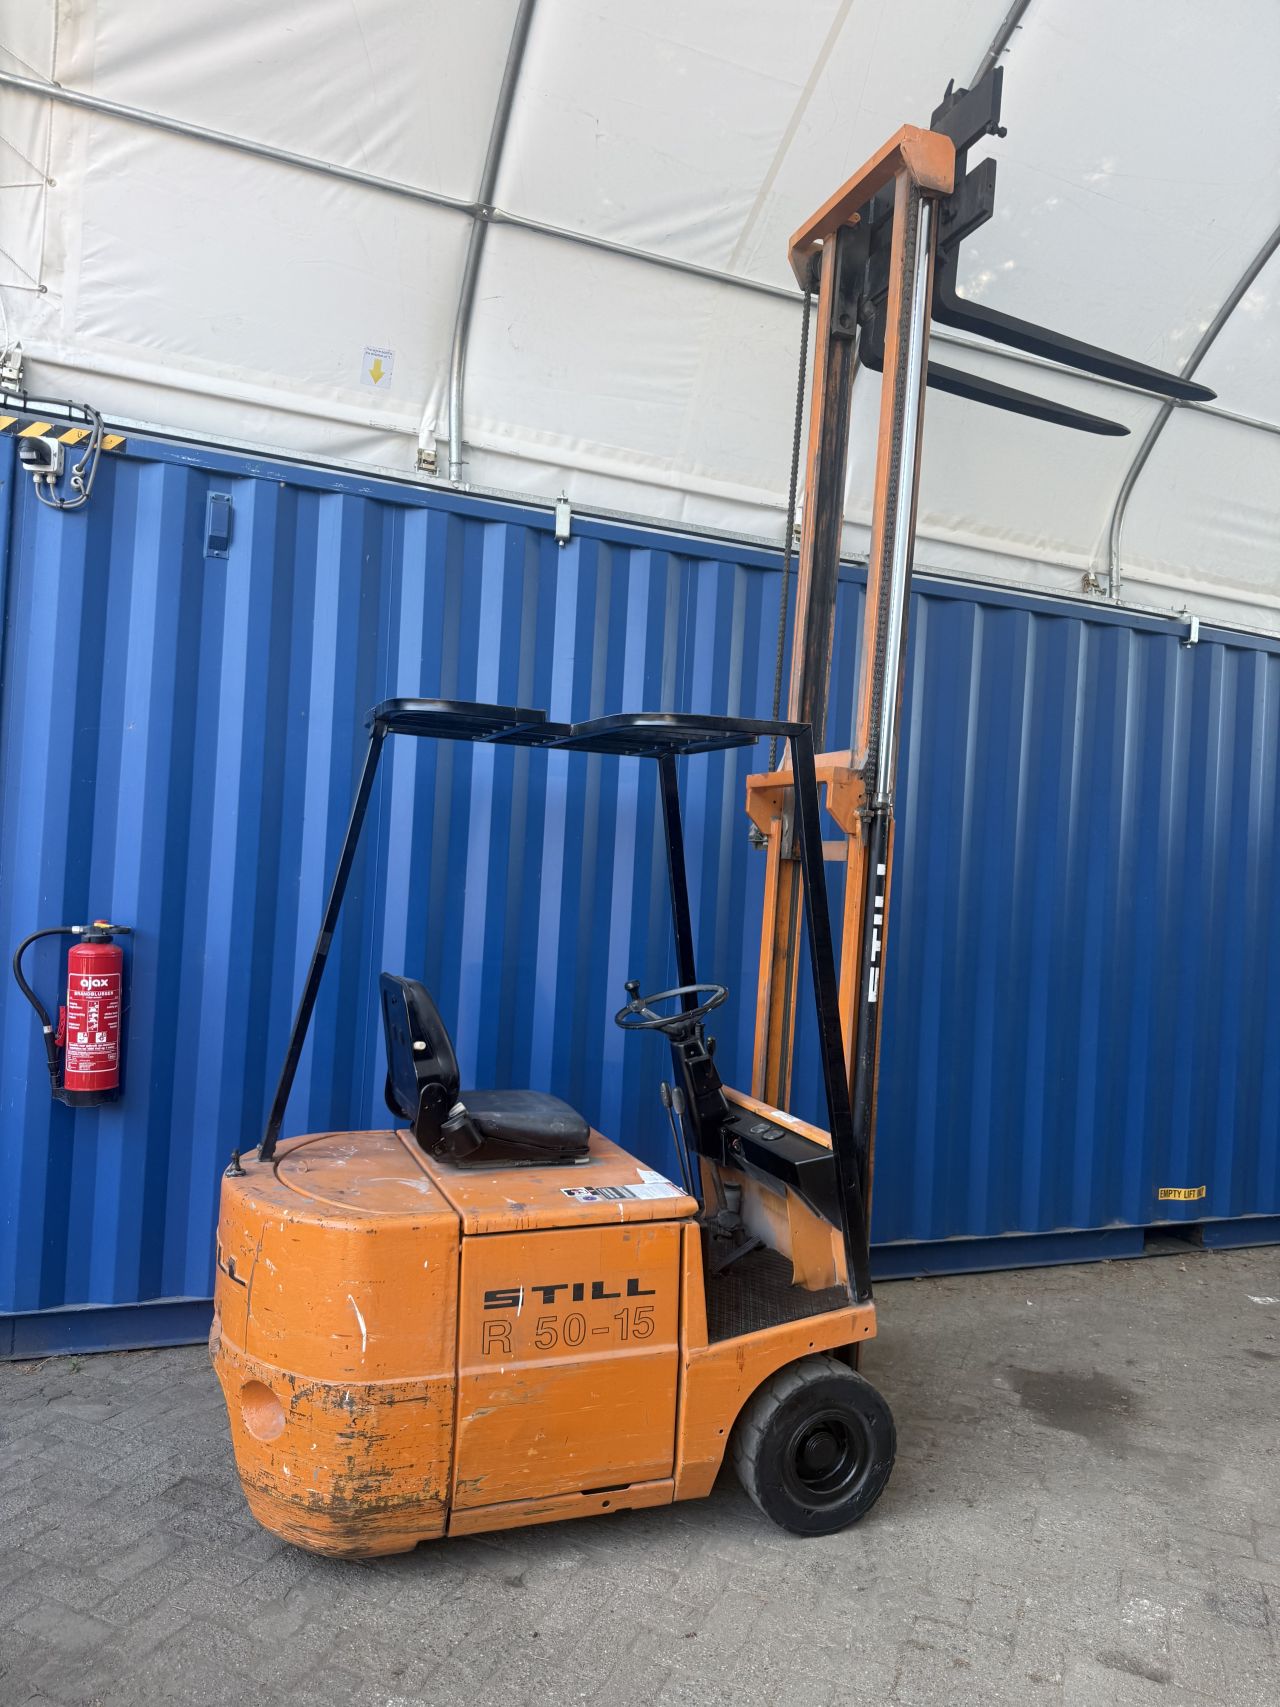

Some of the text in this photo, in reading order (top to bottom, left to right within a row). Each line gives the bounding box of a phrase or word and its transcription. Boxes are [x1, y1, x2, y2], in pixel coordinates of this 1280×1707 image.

[80, 976, 109, 990] ajax
[1159, 1189, 1182, 1198] EMPTY
[1183, 1189, 1196, 1199] LIFT
[483, 1278, 656, 1310] STILL
[482, 1305, 656, 1355] R 50-15
